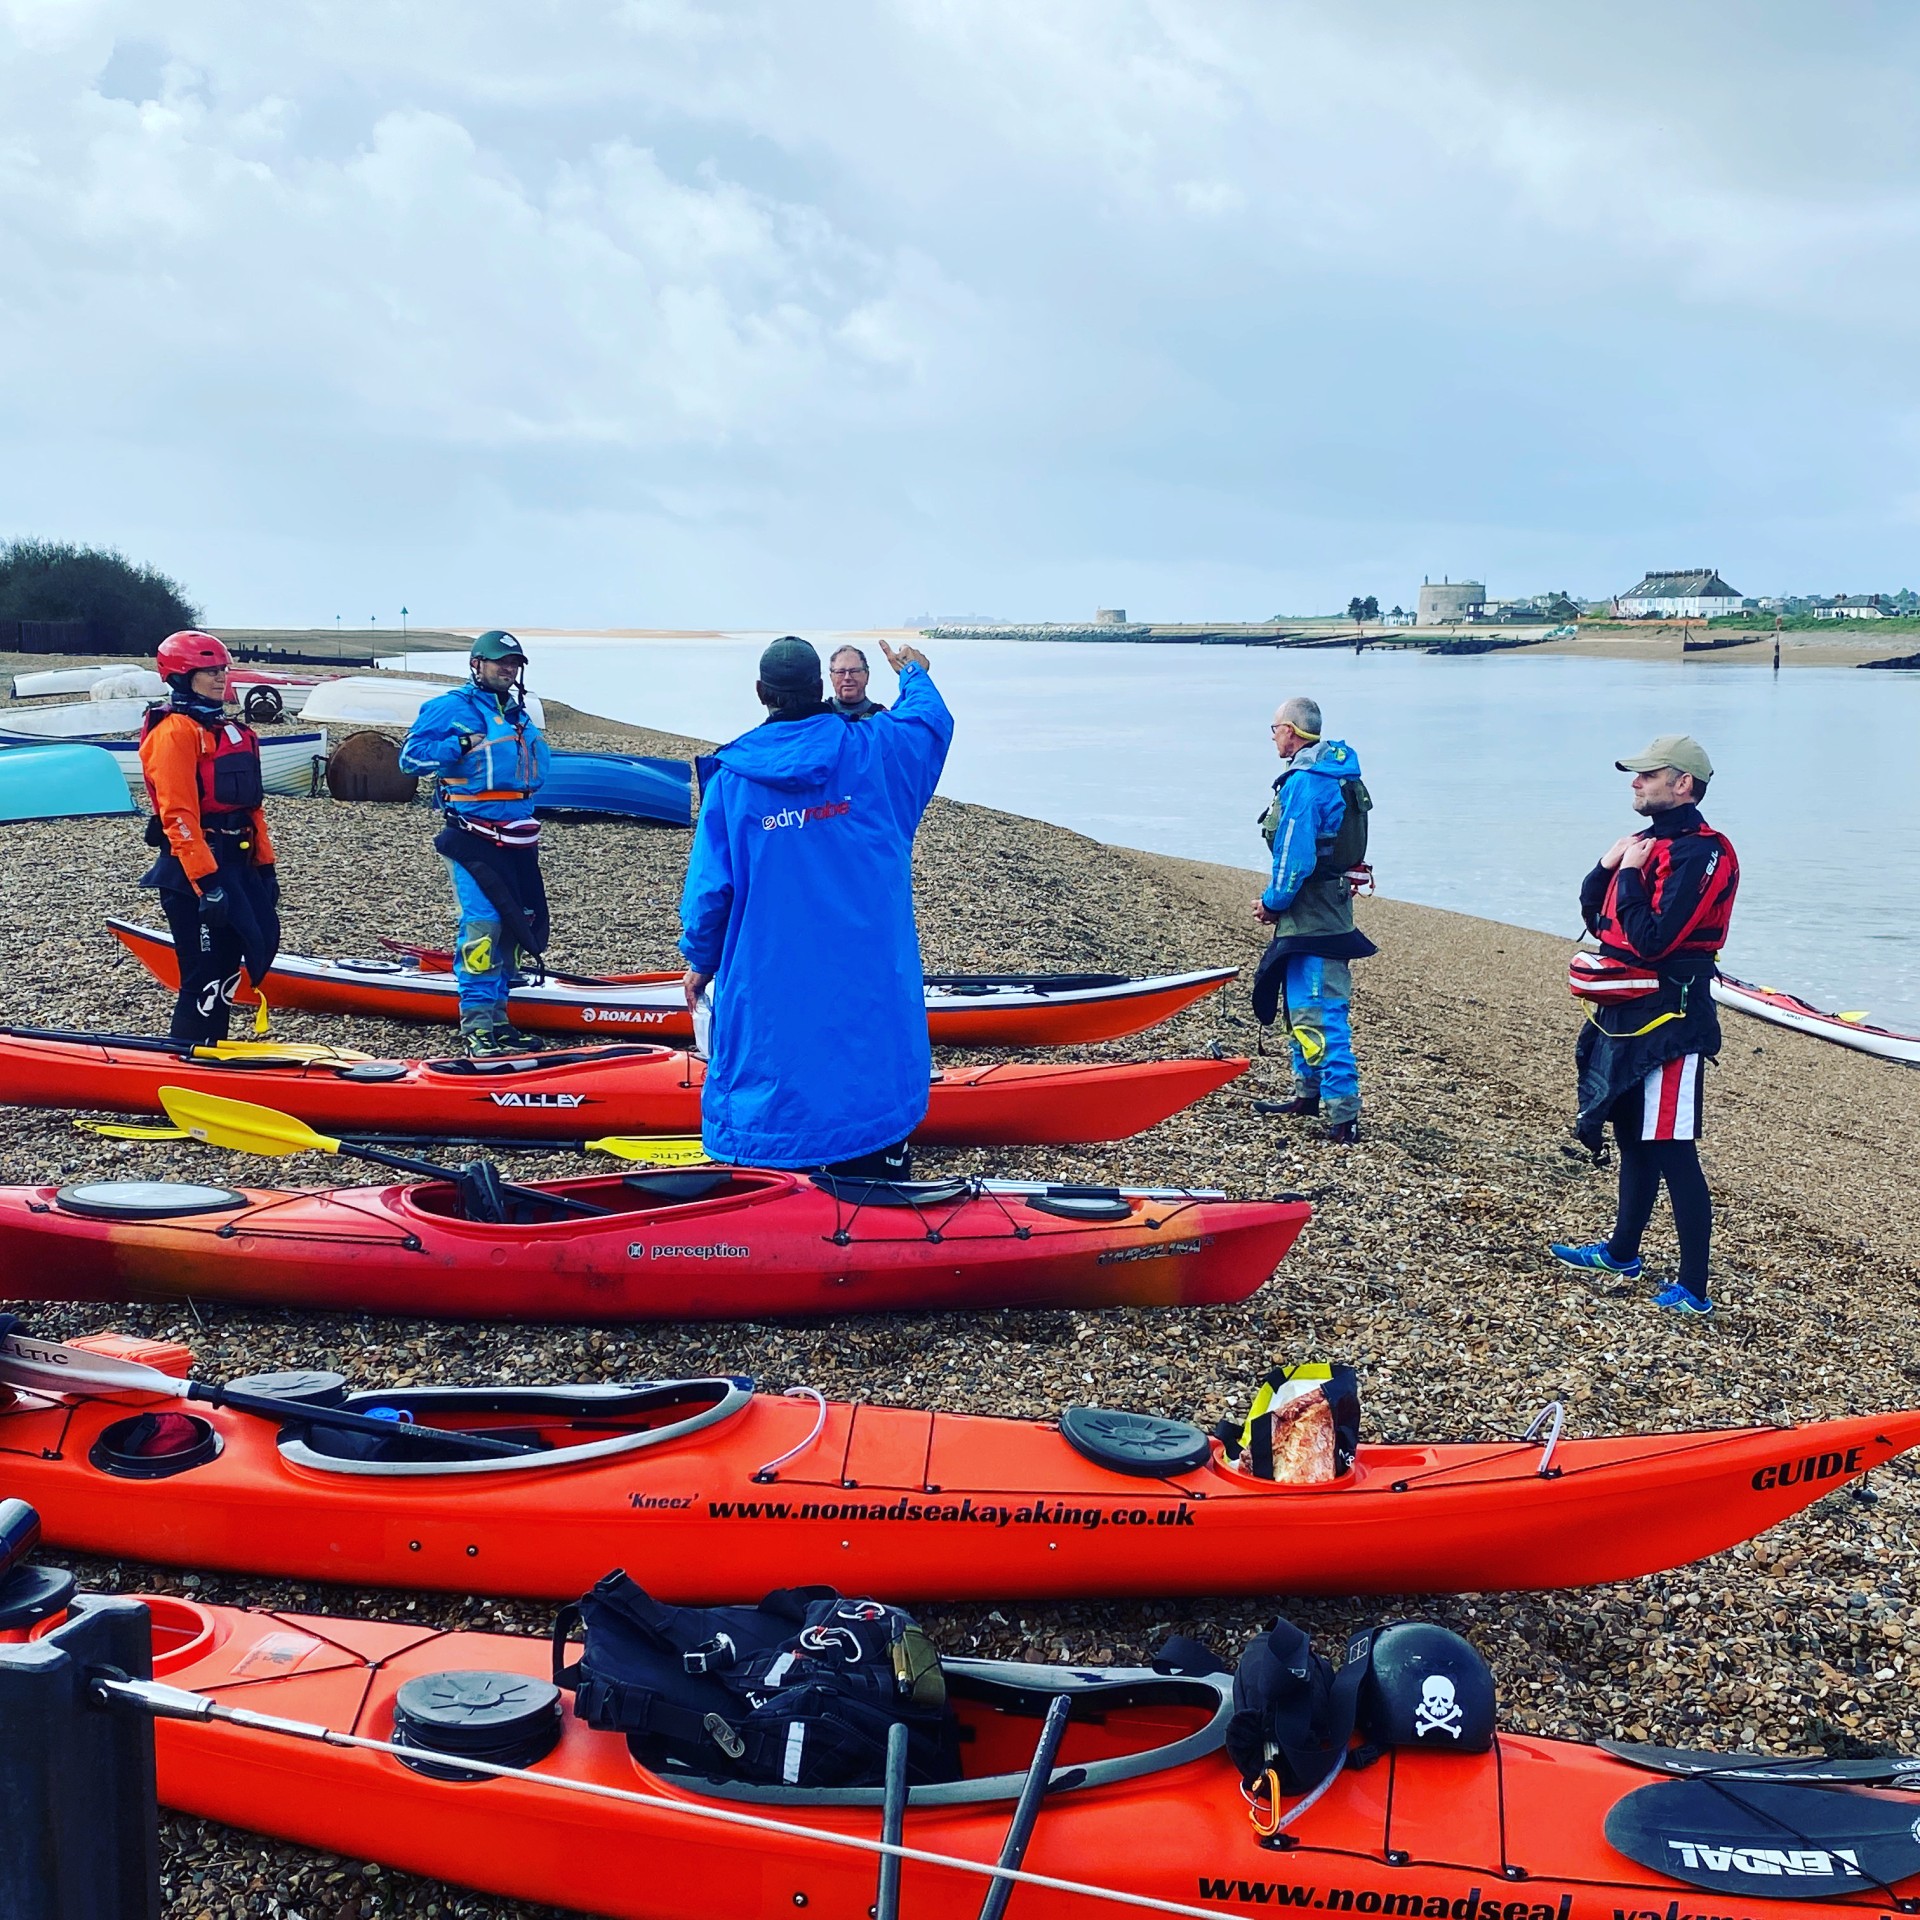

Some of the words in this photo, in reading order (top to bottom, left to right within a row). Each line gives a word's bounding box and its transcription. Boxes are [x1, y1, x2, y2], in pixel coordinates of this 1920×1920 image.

[777, 800, 849, 829] dryrobe
[597, 1010, 677, 1024] ROMANY
[489, 1092, 586, 1108] VALLEY
[651, 1243, 750, 1260] perception
[1751, 1446, 1866, 1491] GUIDE
[708, 1497, 1196, 1530] www.nomadseakayaking.co.uk
[1668, 1840, 1862, 1876] LENDAL
